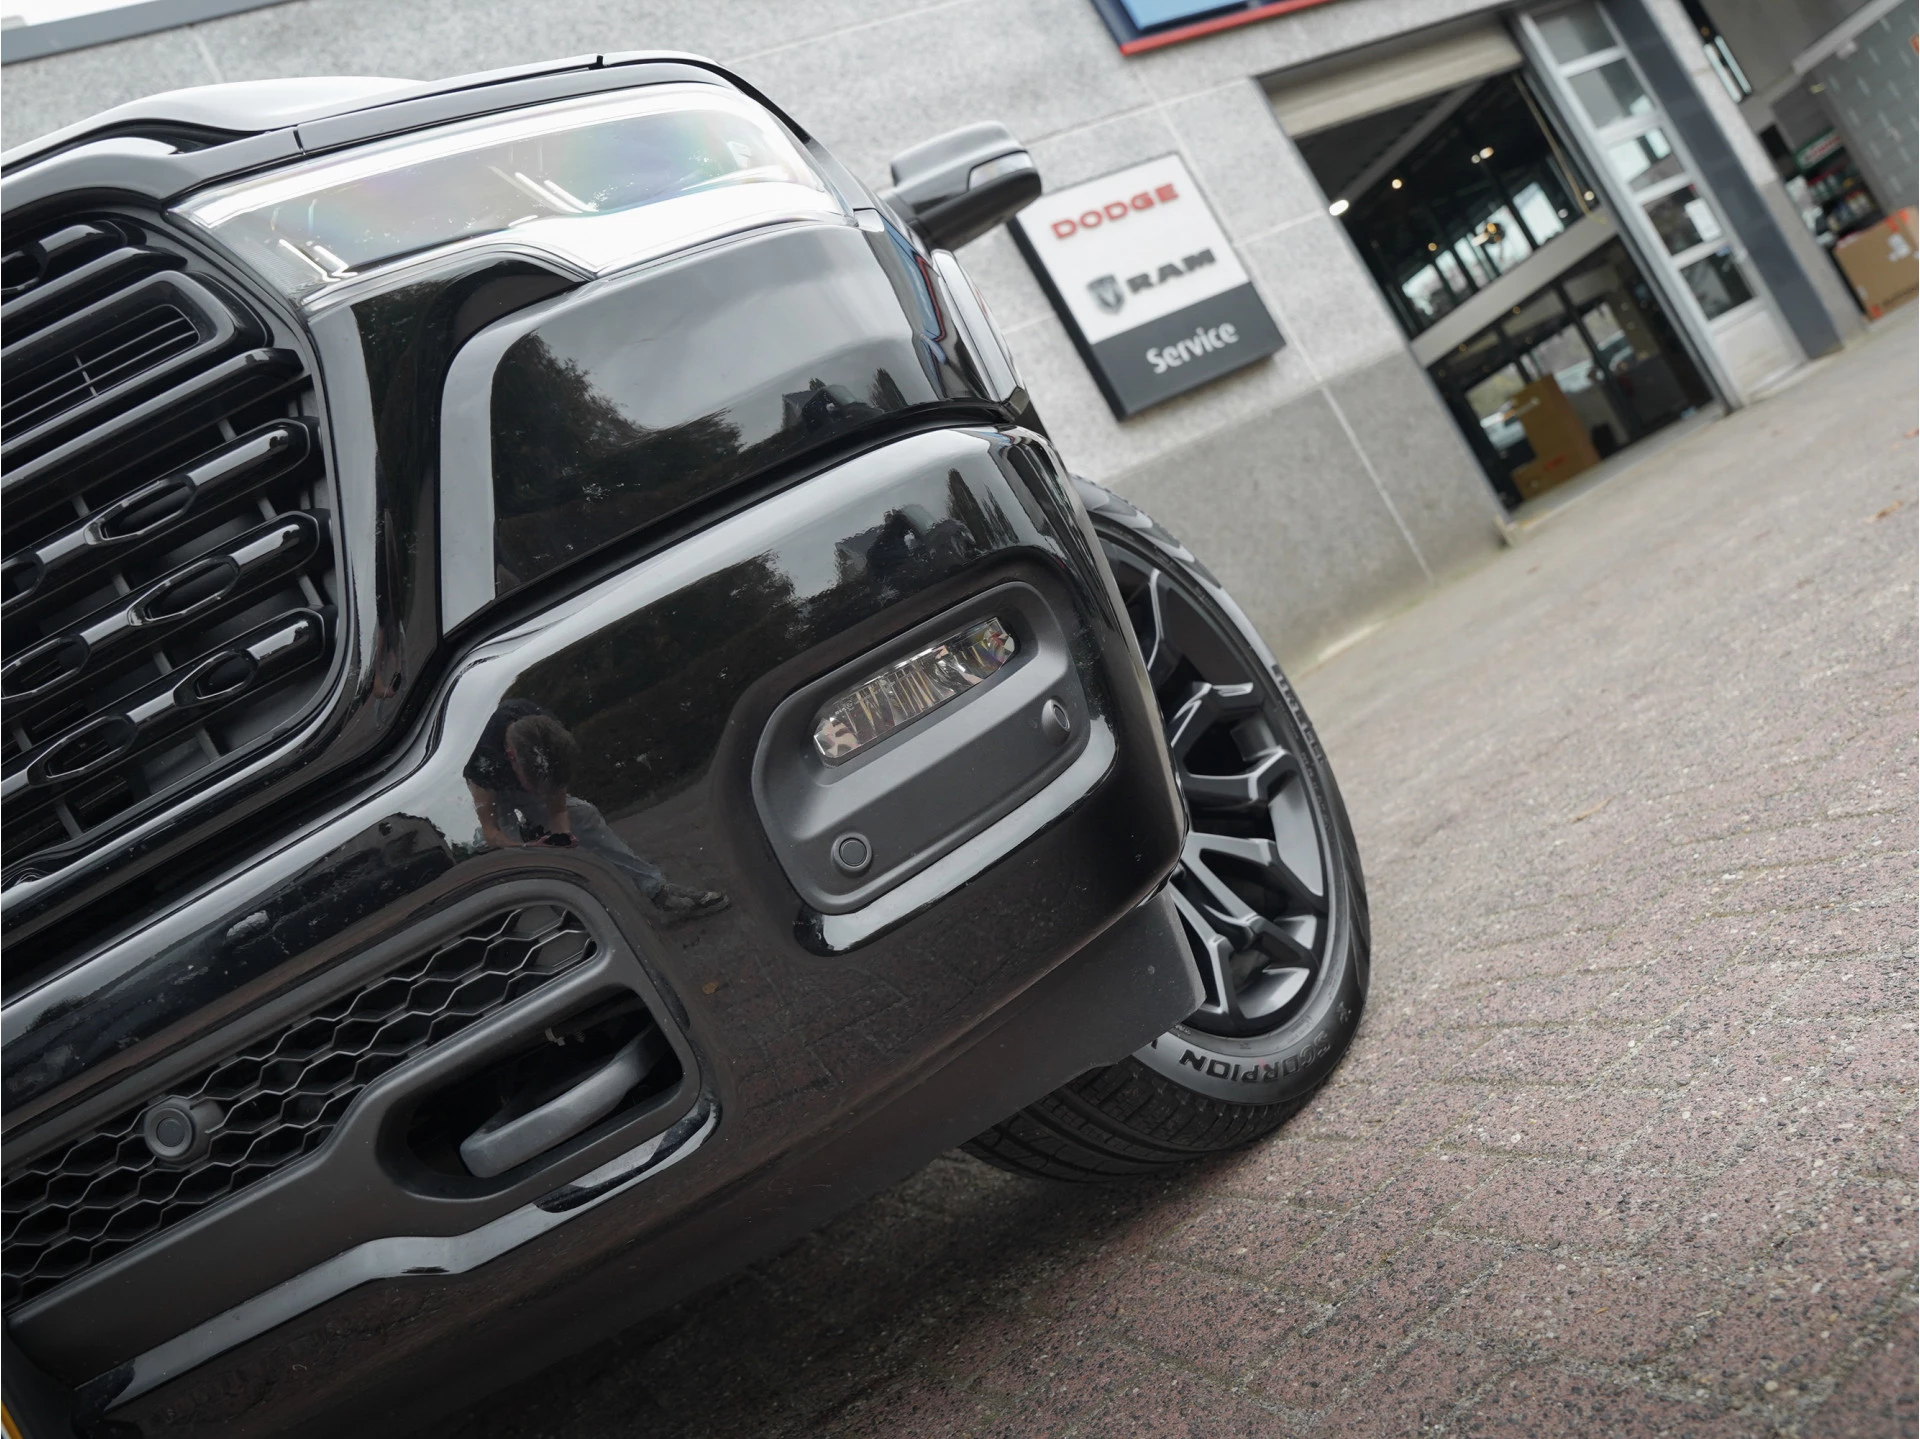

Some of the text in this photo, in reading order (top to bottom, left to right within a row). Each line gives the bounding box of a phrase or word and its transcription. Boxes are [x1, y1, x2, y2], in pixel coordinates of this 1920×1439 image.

[1051, 183, 1179, 239] DODGE
[1126, 248, 1216, 294] RAM
[1146, 322, 1239, 374] Service
[1179, 1032, 1331, 1083] SCORPION
